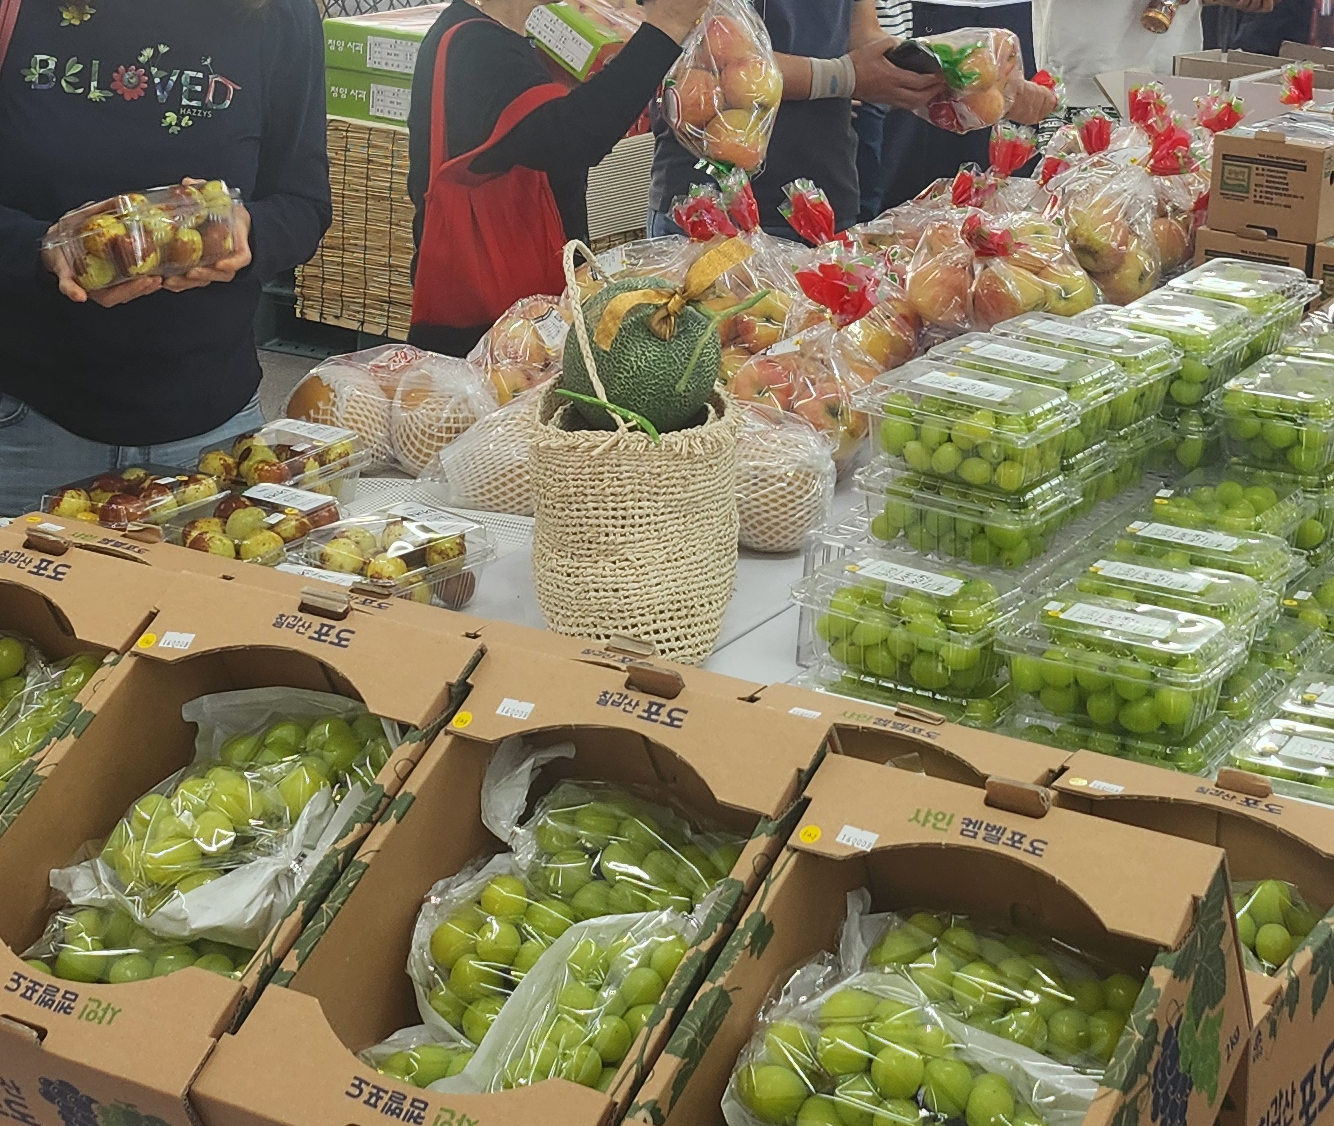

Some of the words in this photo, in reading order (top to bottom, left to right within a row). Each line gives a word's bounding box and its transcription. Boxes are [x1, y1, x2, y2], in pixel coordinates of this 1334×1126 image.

[347, 41, 364, 54] 사과
[23, 53, 242, 112] BELOVED
[350, 89, 367, 102] 사과
[179, 107, 213, 118] HAZZYS
[26, 557, 73, 582] 포도
[272, 612, 313, 635] 칠갑산
[308, 621, 357, 649] 포도
[596, 689, 641, 714] 칠갑산
[636, 699, 689, 730] 포도
[1234, 796, 1285, 816] 포도
[907, 807, 955, 833] 샤인
[77, 996, 122, 1026] 샤인
